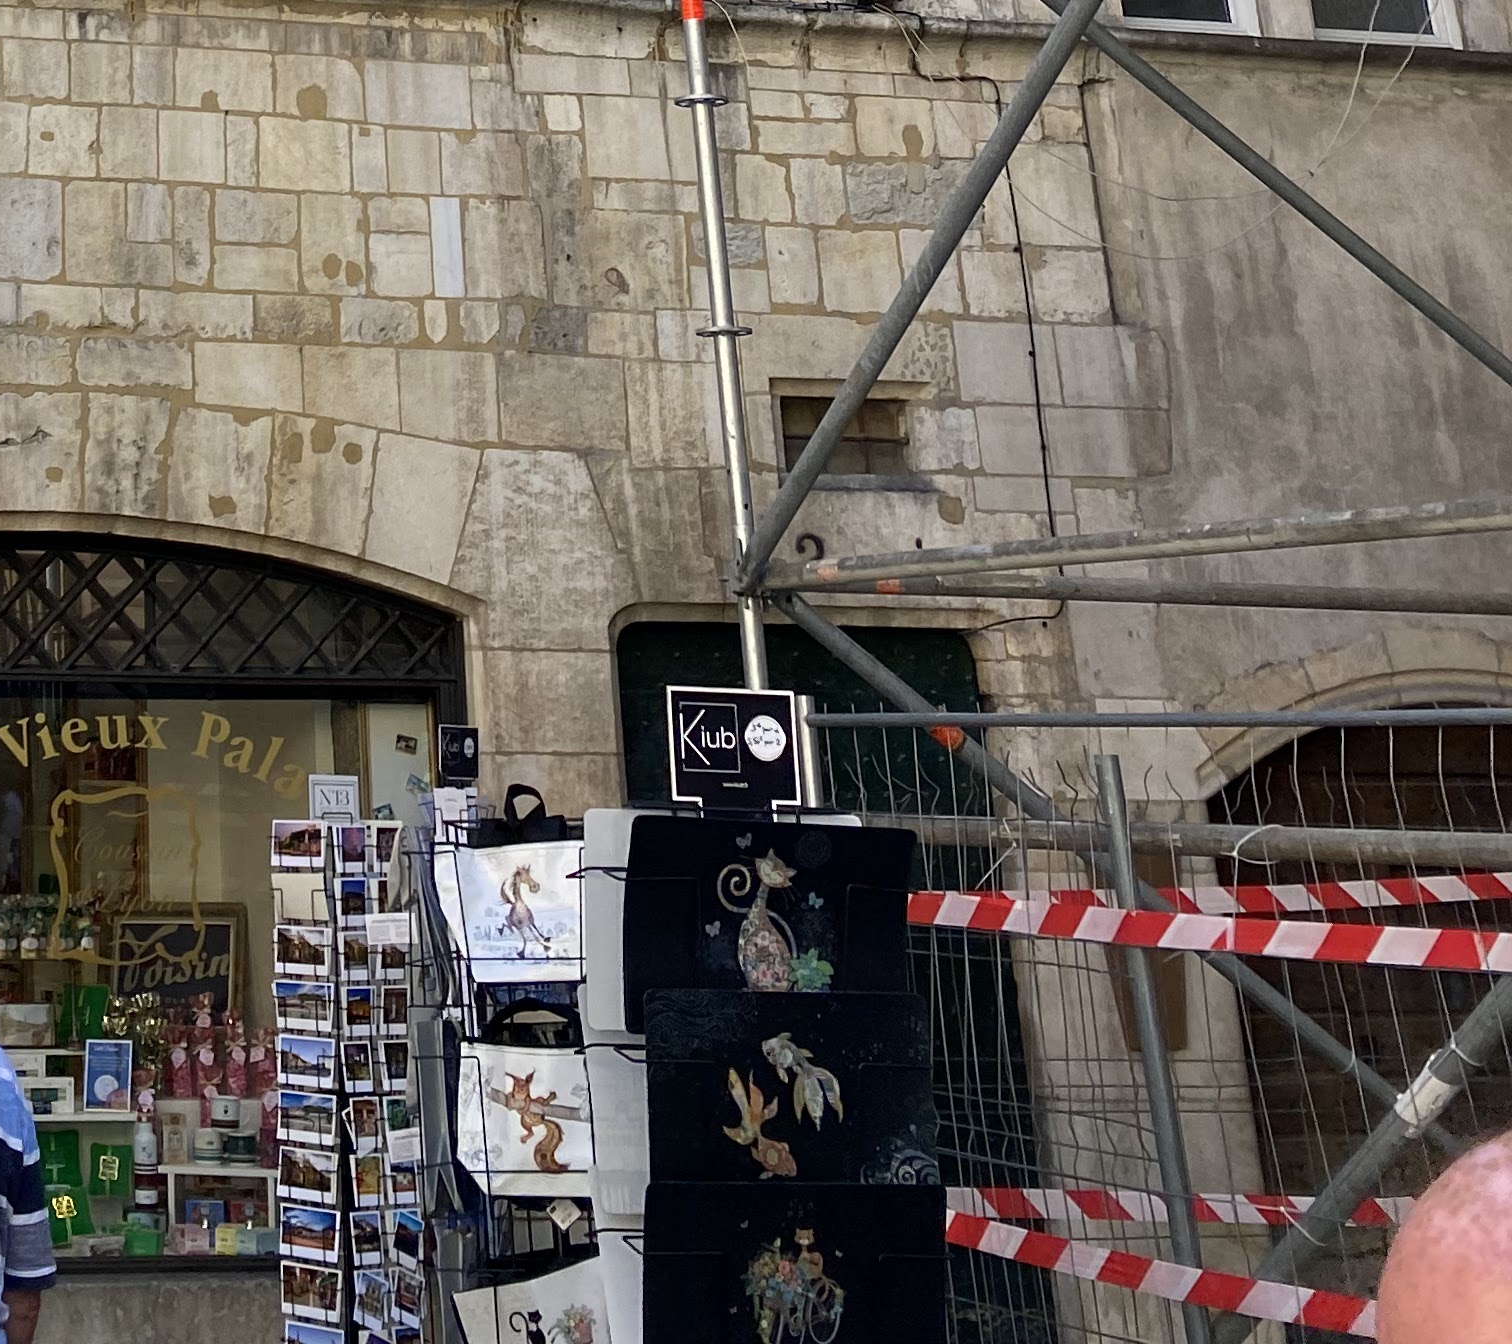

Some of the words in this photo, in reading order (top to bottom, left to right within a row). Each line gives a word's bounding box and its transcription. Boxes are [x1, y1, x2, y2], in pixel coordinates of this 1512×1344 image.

[190, 711, 307, 800] Pala
[679, 708, 736, 765] Kiub
[123, 924, 230, 992] Voisin
